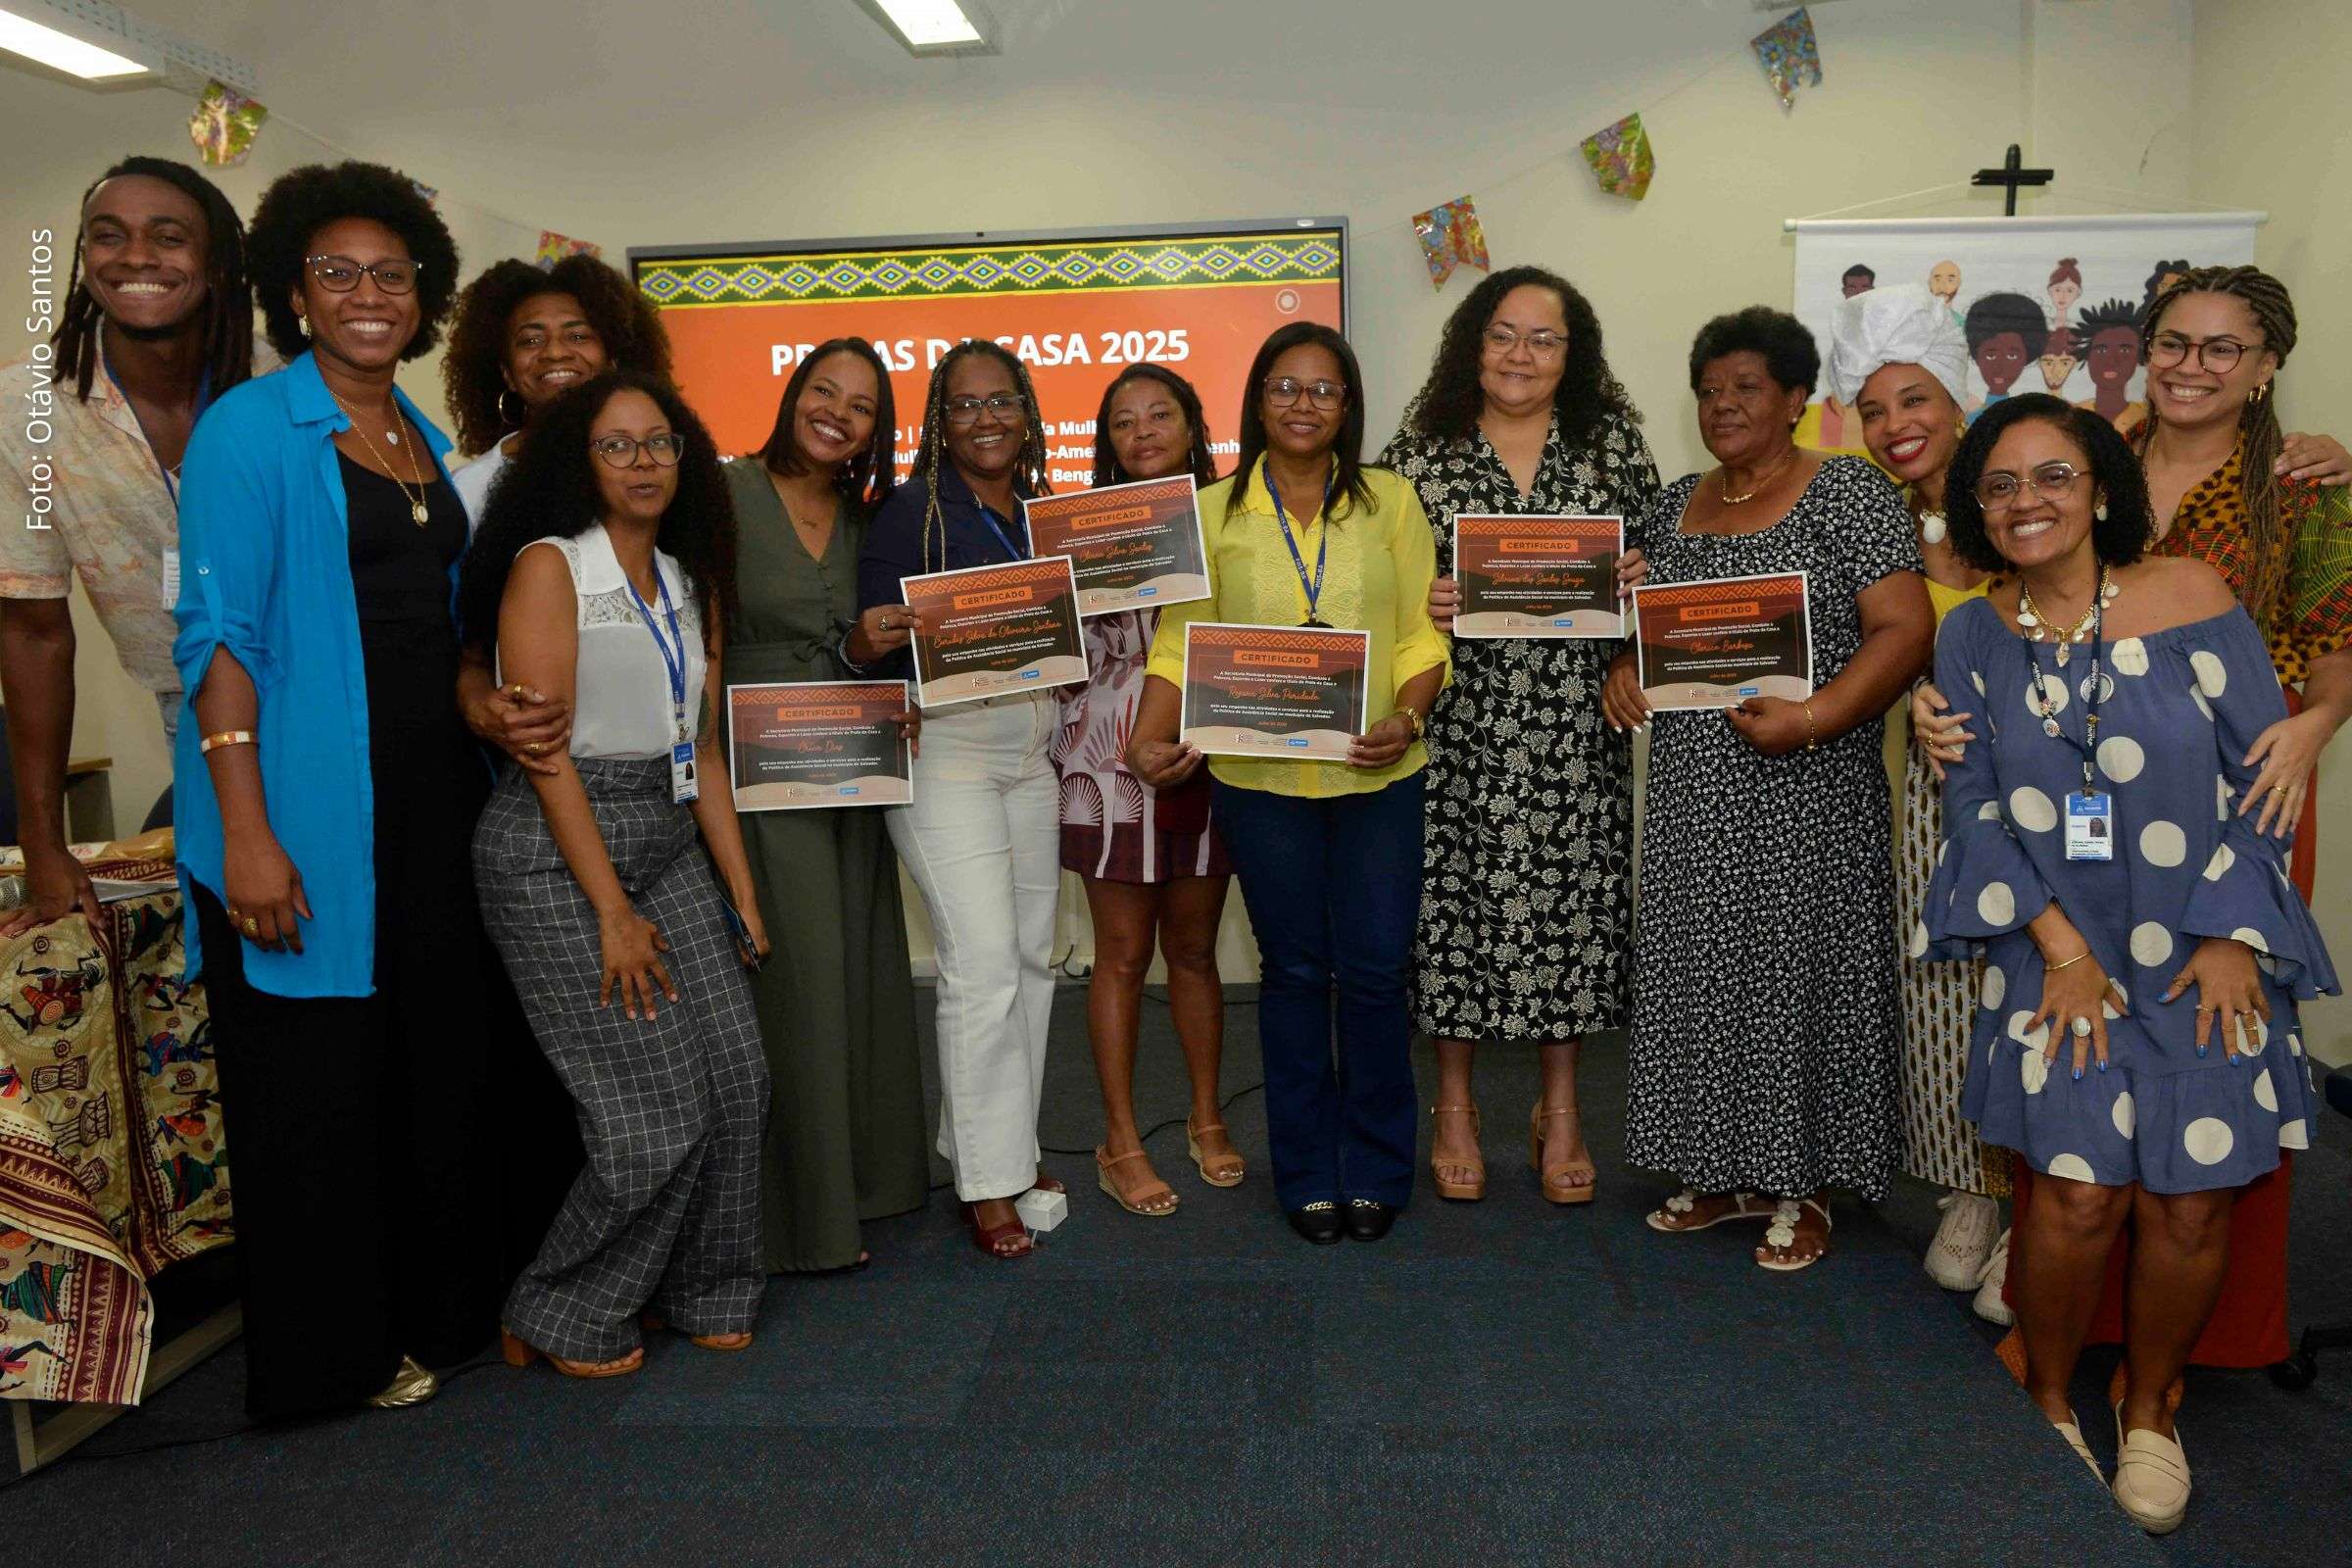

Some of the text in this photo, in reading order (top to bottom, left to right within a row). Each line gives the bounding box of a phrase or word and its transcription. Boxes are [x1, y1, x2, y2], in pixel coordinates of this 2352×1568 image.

[771, 340, 916, 376] PRAS
[1100, 329, 1189, 364] 2025
[1078, 510, 1144, 526] CERTIFICADO
[1506, 541, 1571, 550] CERTIFICADO
[961, 591, 1026, 606] CERTIFICADO
[1687, 606, 1752, 617] CERTIFICADO
[1241, 654, 1312, 664] CERTIFICADO
[785, 709, 855, 719] CERTIFICADO
